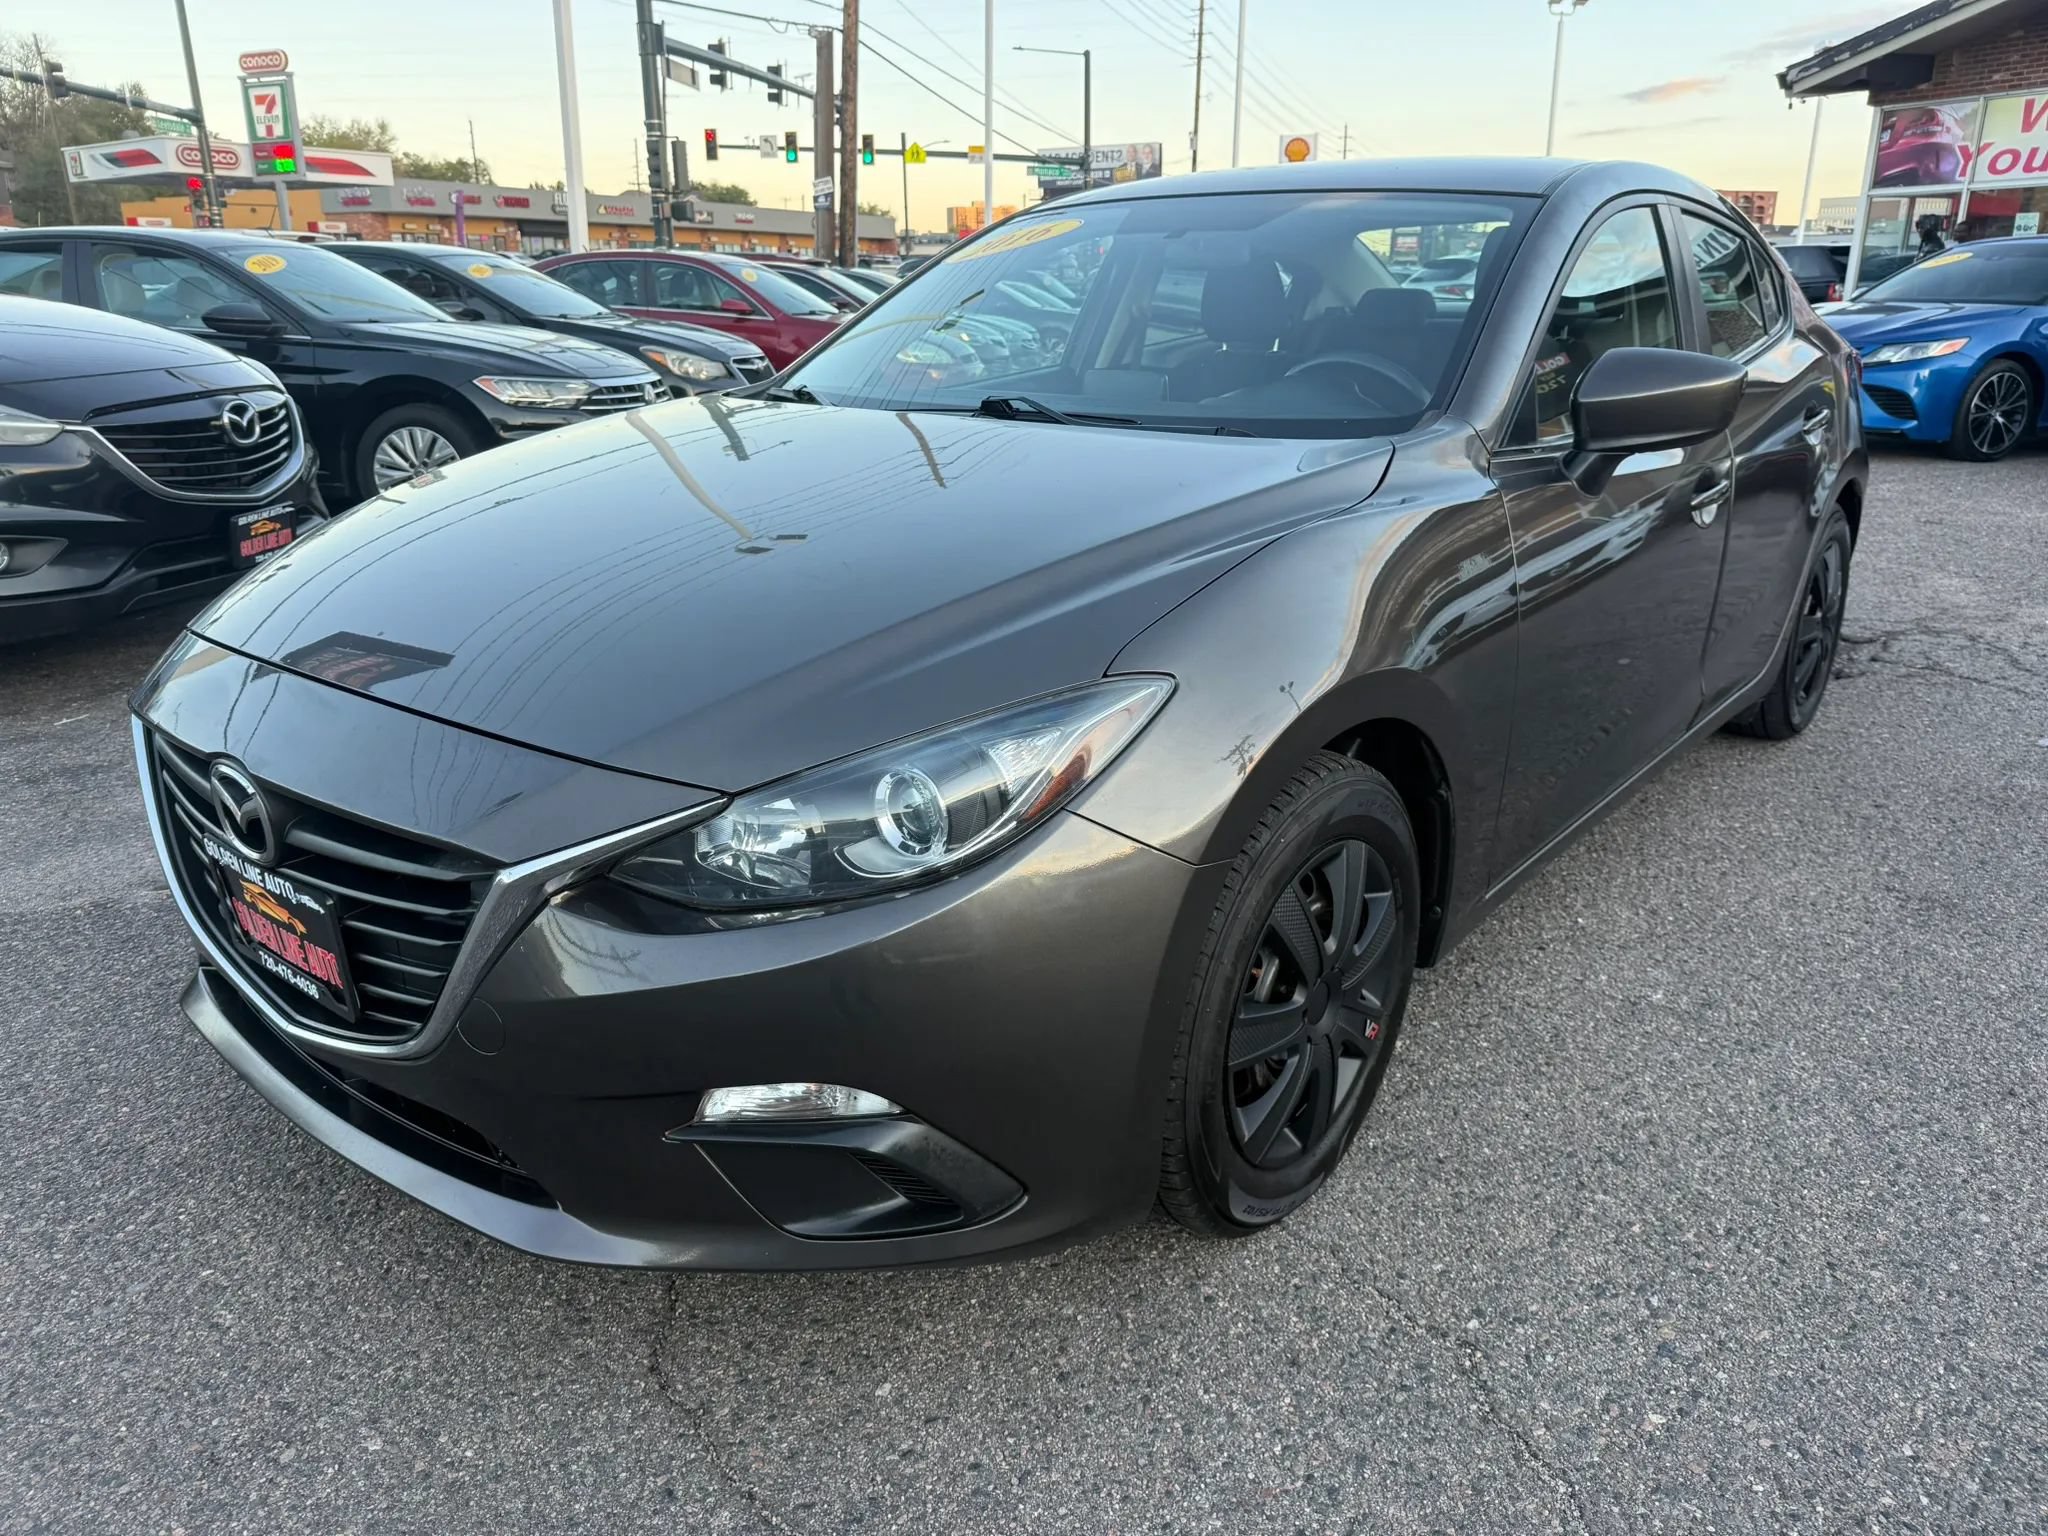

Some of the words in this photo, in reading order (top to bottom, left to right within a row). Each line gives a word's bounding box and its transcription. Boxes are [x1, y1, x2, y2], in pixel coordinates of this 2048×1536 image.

[254, 93, 277, 138] 7
[203, 837, 242, 875] GOLDEN
[239, 860, 263, 883] LINE
[265, 872, 297, 904] AUTO
